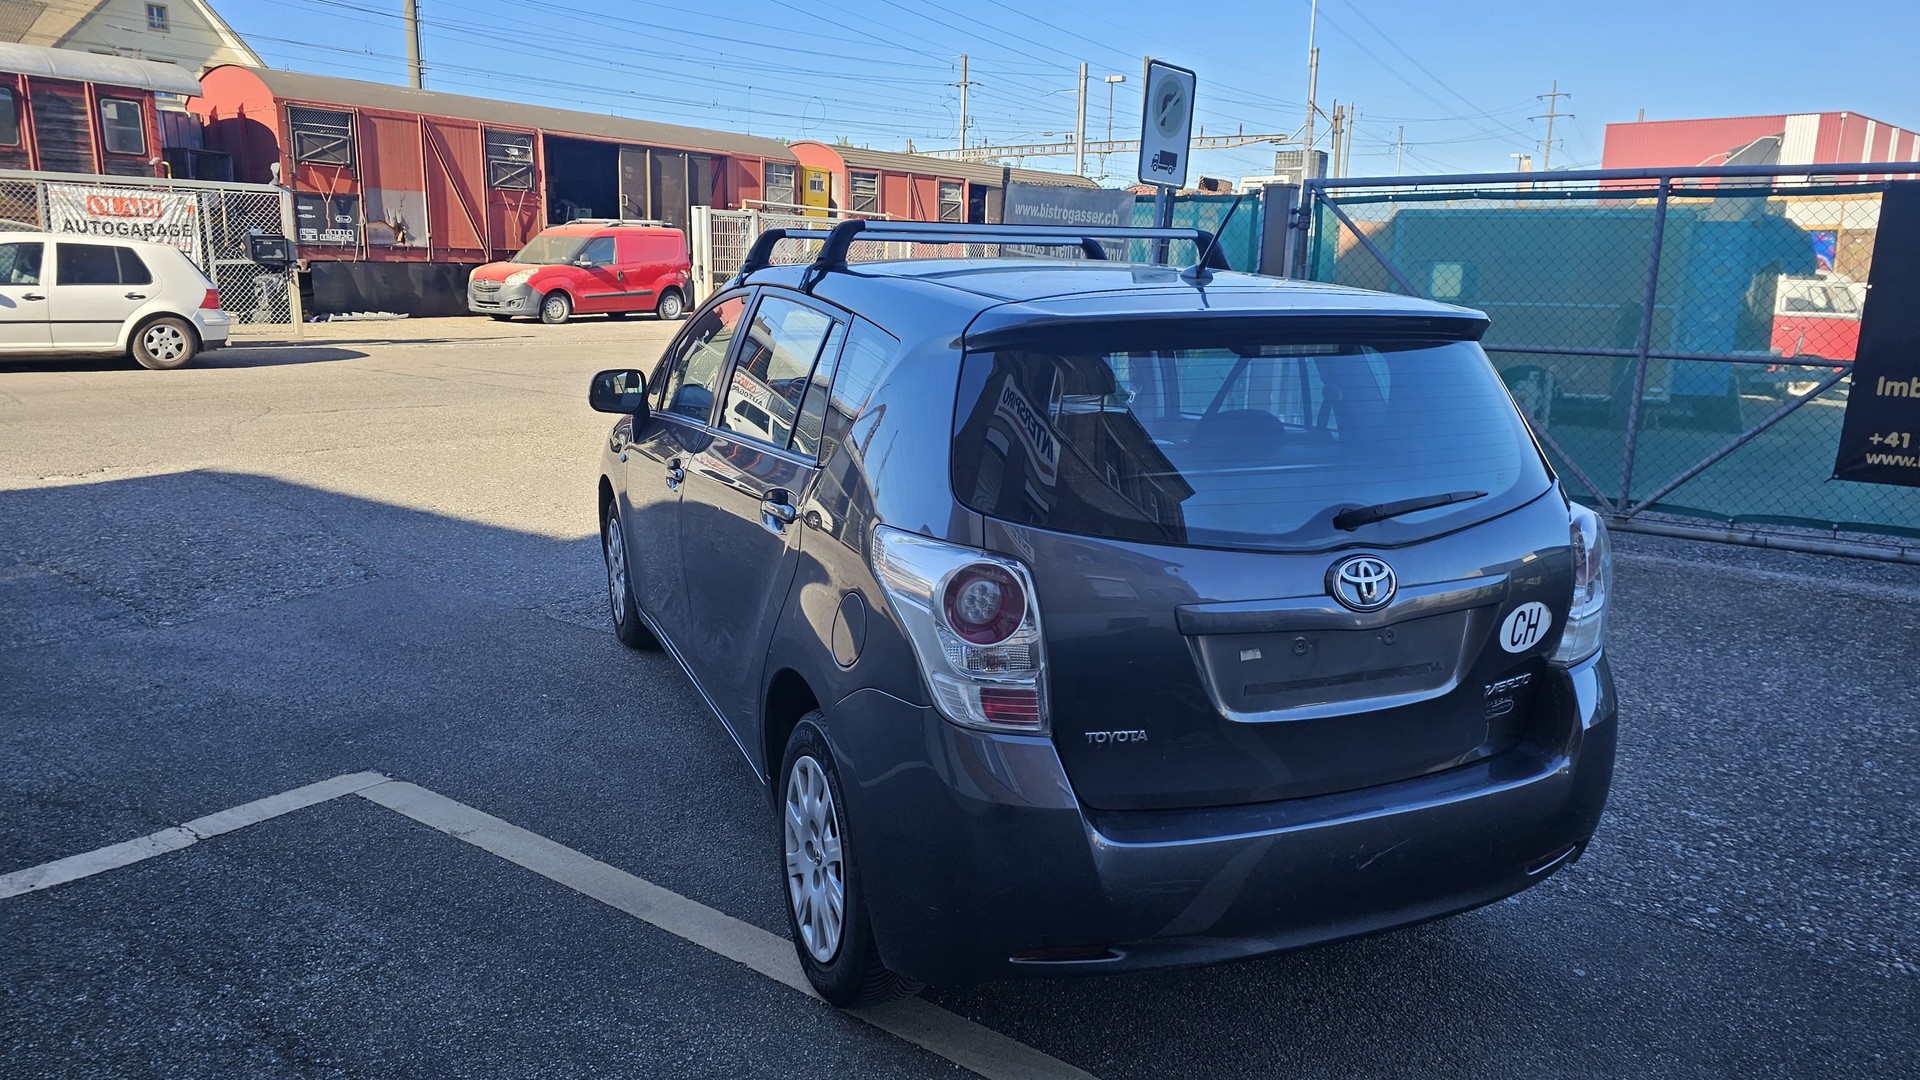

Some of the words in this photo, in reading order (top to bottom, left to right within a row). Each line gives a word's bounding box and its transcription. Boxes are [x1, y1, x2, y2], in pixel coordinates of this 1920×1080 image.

[1015, 203, 1119, 226] www.bistrogasser.ch
[62, 219, 192, 238] AUTOGARAGE
[1869, 432, 1910, 448] +41
[1865, 453, 1920, 467] www.
[1510, 607, 1542, 647] CH
[1085, 729, 1148, 744] TOYOTA
